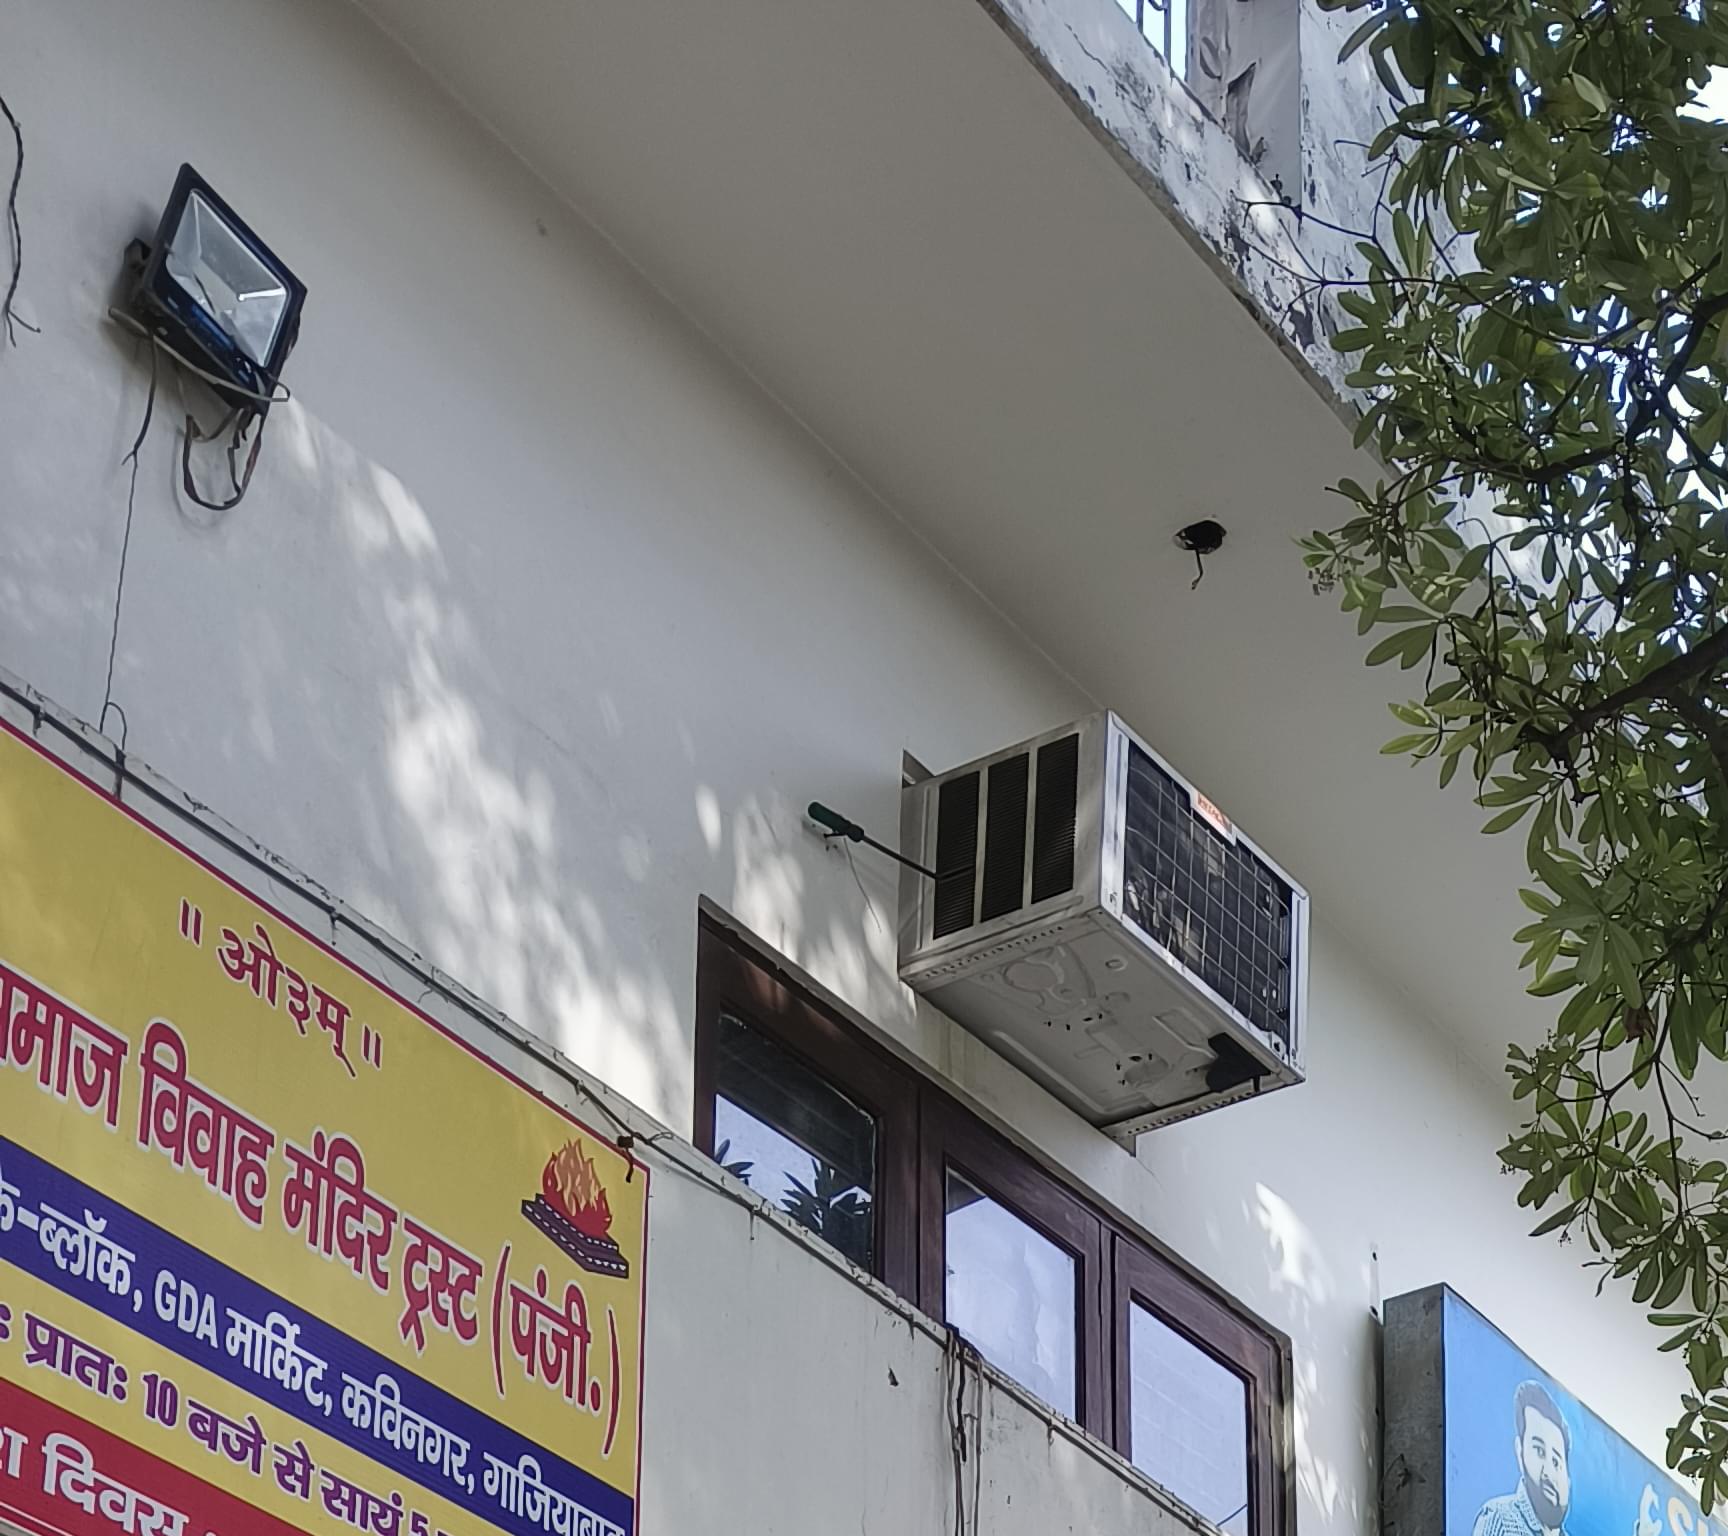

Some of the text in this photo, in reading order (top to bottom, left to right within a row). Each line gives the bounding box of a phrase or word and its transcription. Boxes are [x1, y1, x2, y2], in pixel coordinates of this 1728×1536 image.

[139, 1022, 275, 1224] विवाह
[284, 1130, 397, 1291] मंदिर
[400, 1218, 482, 1351] ट्रस्ट
[493, 1245, 620, 1455] (पंजी.)
[143, 1373, 178, 1427] 10
[187, 1415, 266, 1475] बजे
[274, 1441, 314, 1499] से
[154, 1269, 218, 1348] GDA
[342, 1373, 474, 1495] कविनगर,
